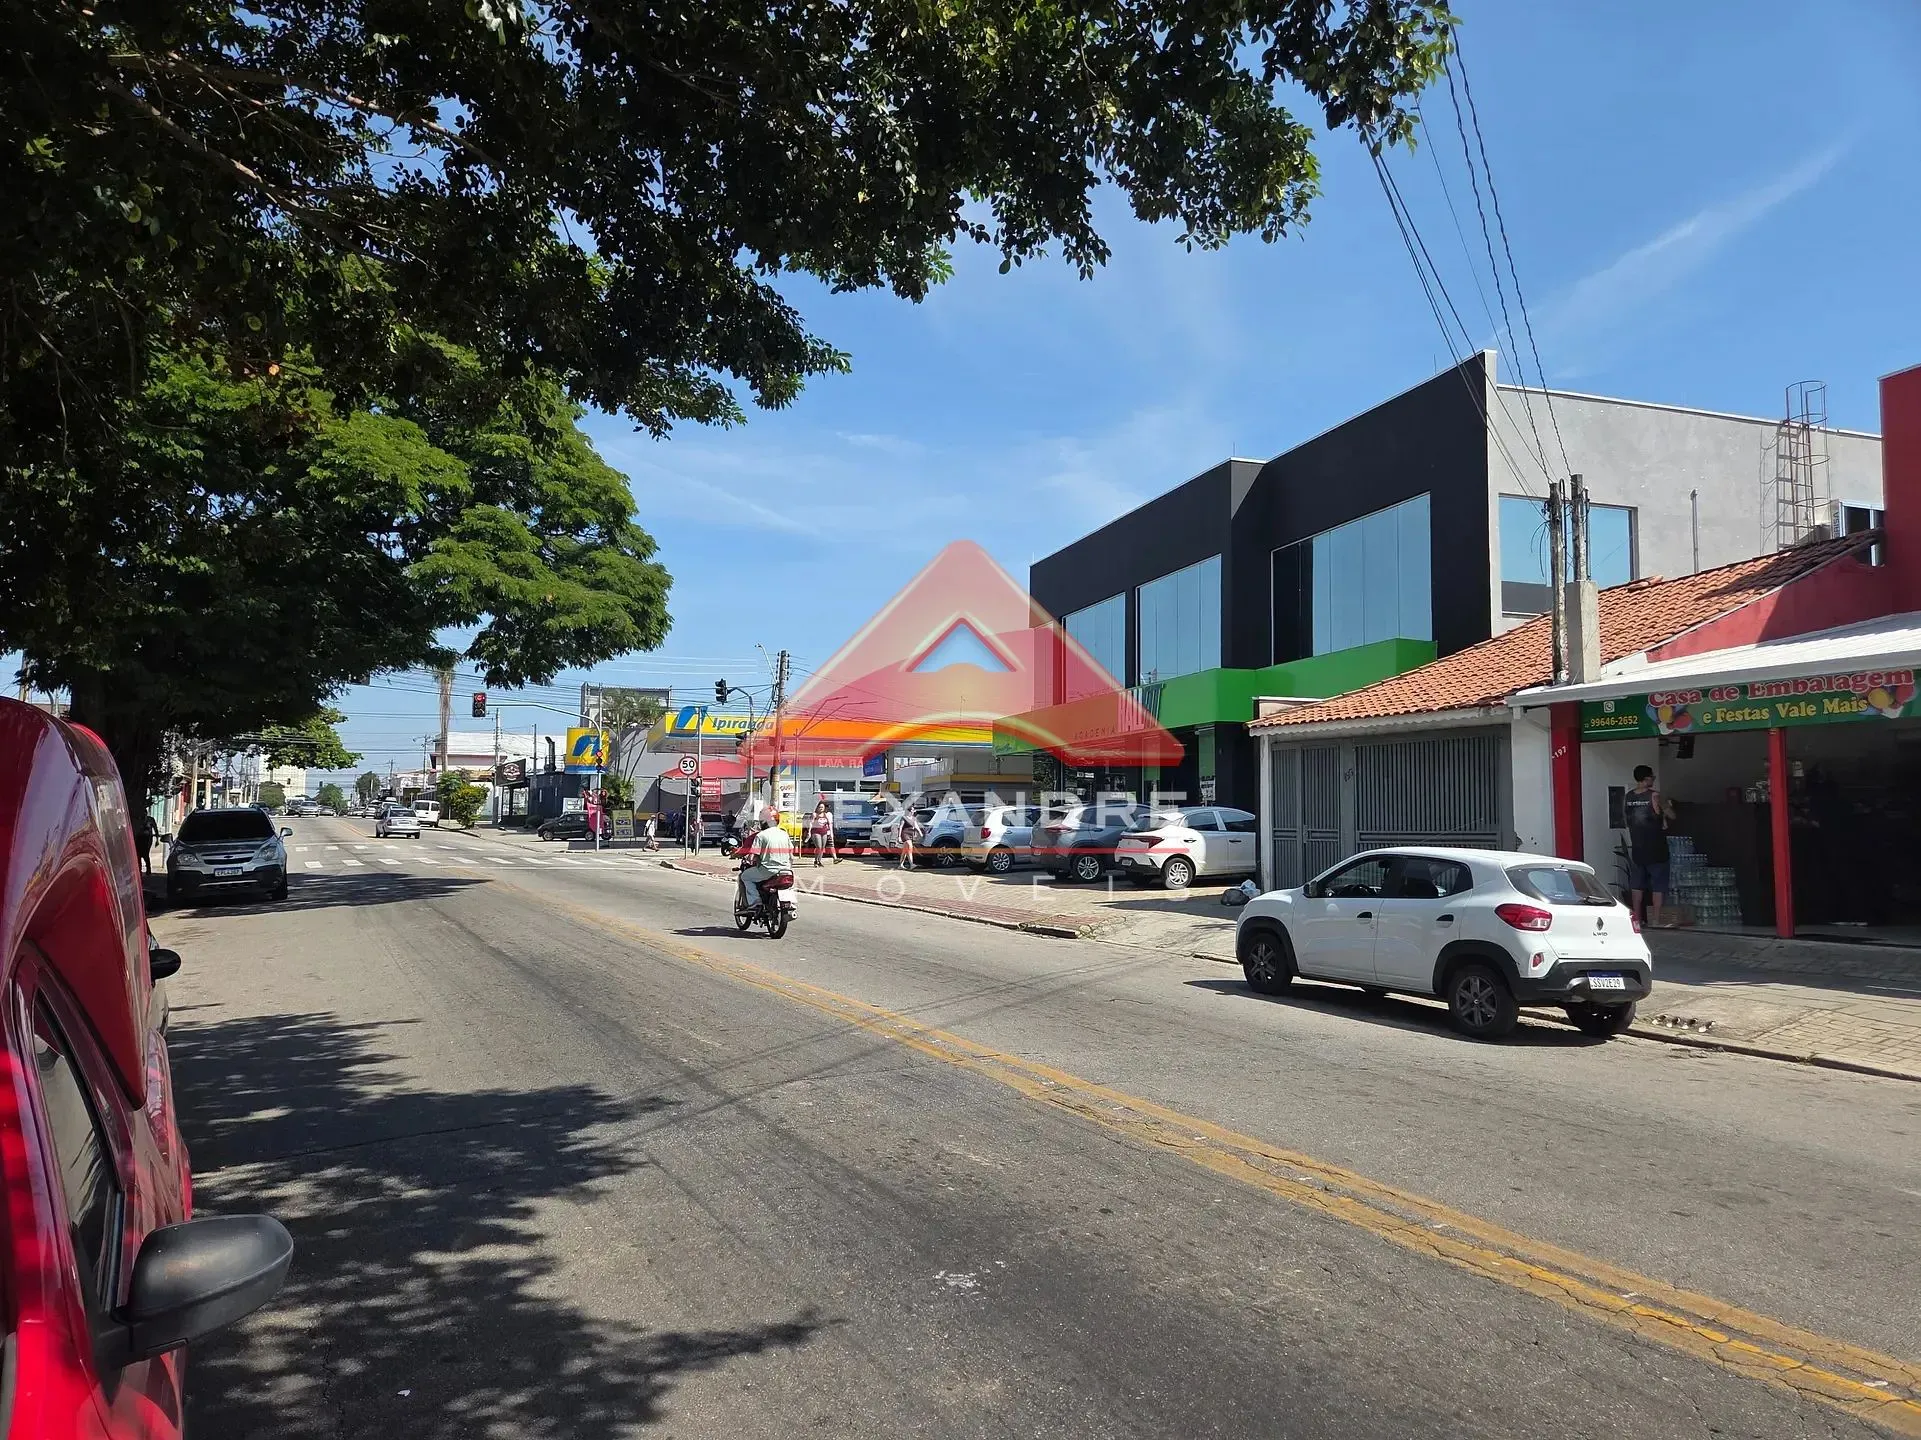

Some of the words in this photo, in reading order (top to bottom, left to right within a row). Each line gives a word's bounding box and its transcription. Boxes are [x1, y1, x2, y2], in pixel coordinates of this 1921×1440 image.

[1648, 689, 1702, 708] Casa
[1709, 686, 1740, 702] de
[1747, 668, 1914, 700] Embalagem
[1703, 712, 1712, 724] e
[1715, 707, 1770, 723] Festas
[1775, 702, 1817, 718] Vale
[1822, 697, 1868, 715] Mais
[1590, 715, 1638, 727] 99646-2652
[682, 760, 695, 769] 50
[819, 758, 844, 768] LAVA
